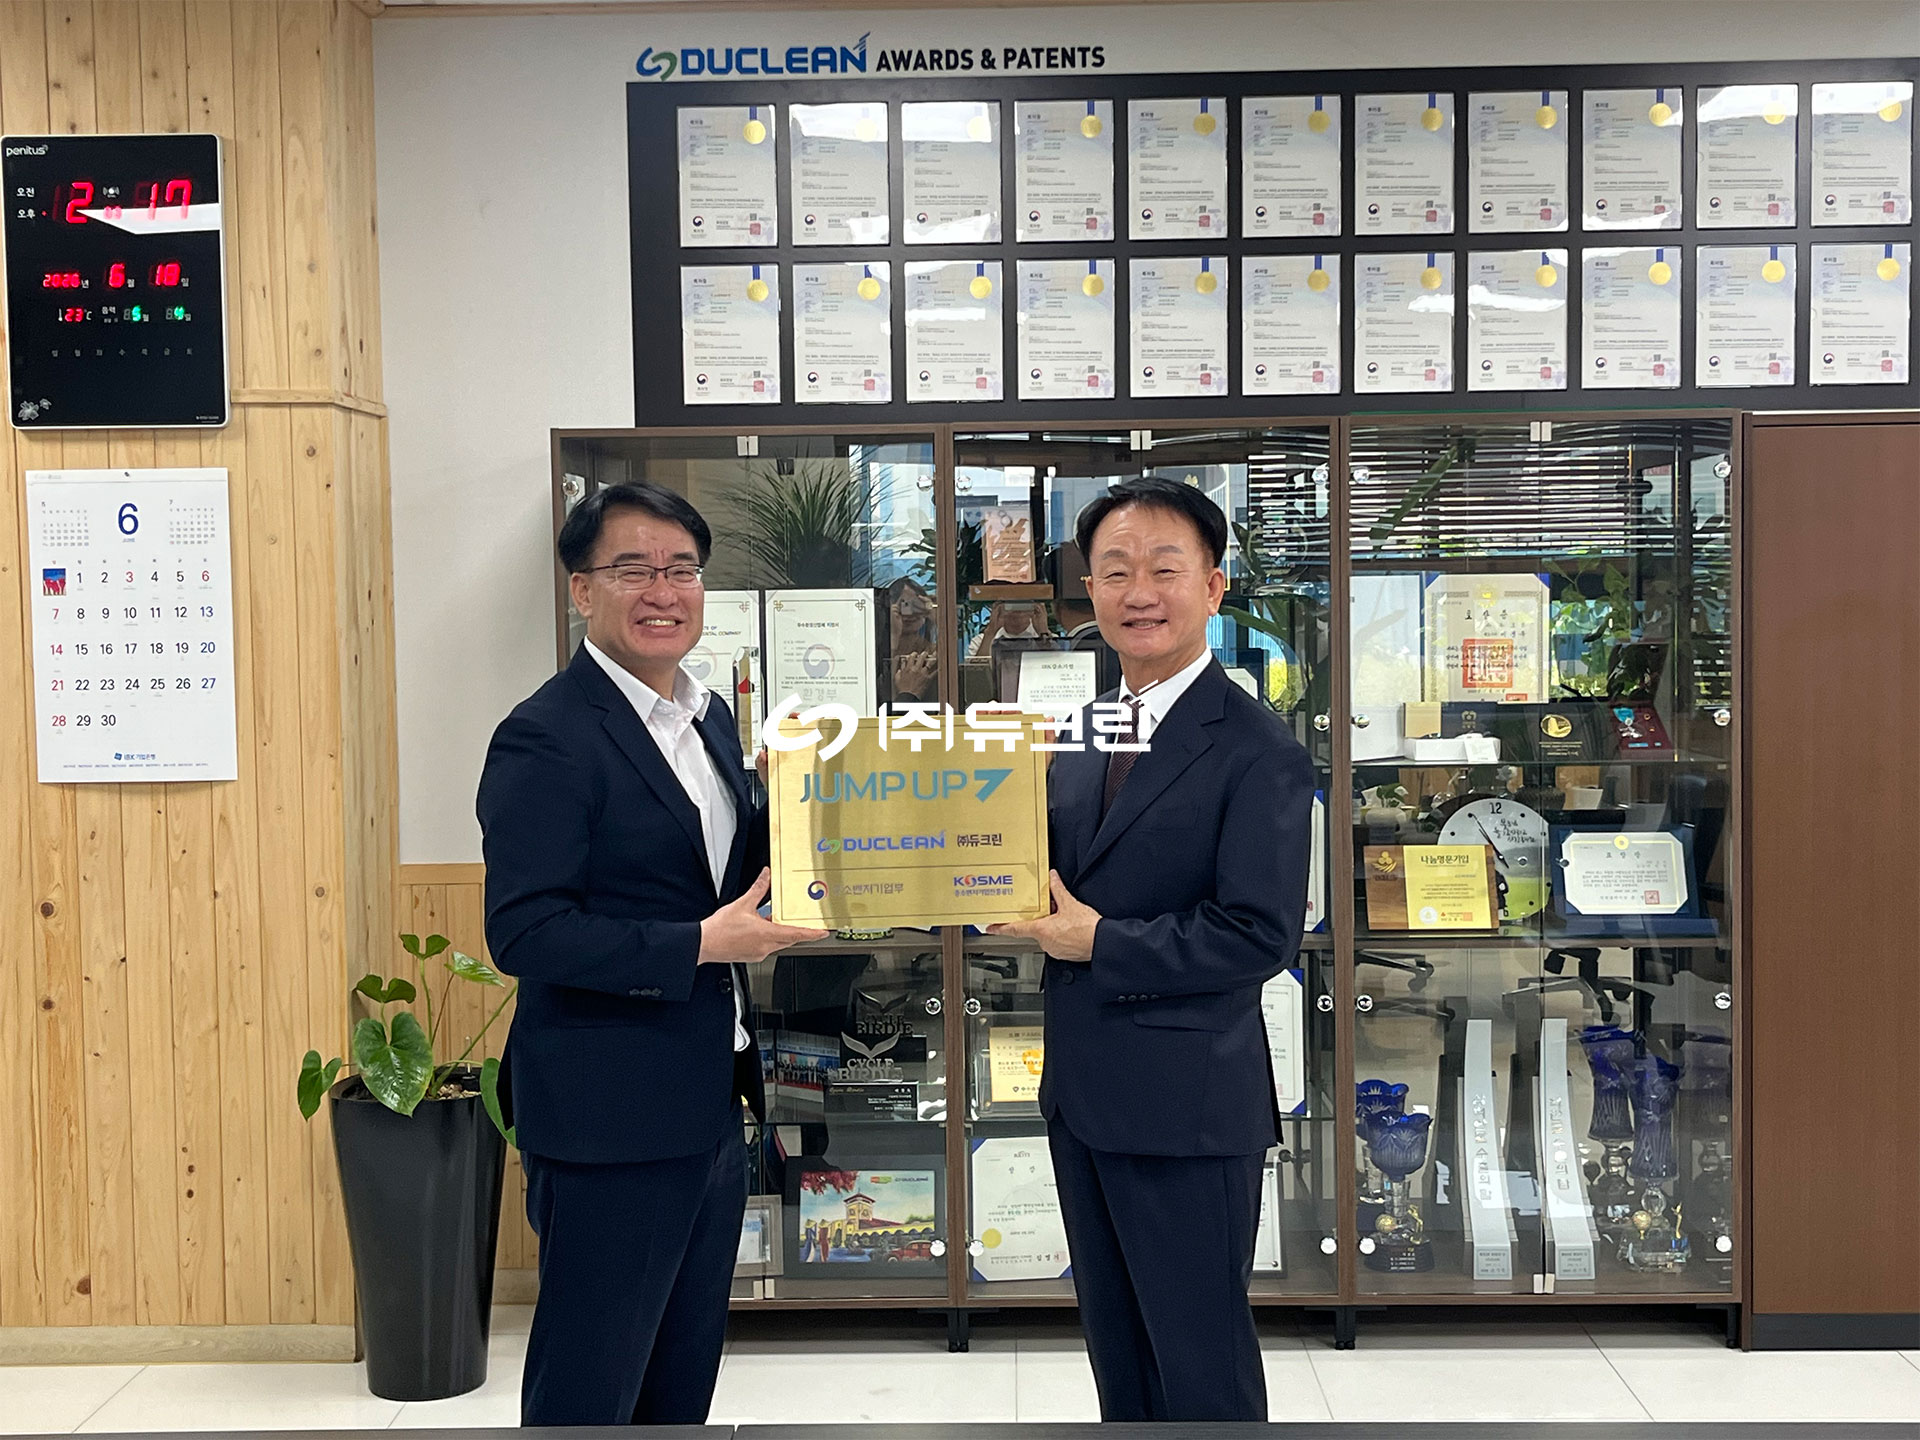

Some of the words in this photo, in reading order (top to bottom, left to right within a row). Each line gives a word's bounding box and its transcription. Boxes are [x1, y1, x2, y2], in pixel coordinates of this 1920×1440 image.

[681, 45, 868, 75] DUCLEAN
[876, 48, 974, 72] AWARDS
[980, 49, 997, 70] &
[1003, 47, 1107, 70] PATENTS
[6, 146, 47, 157] penitus
[16, 187, 35, 198] 오전
[17, 208, 36, 219] 오후
[117, 502, 139, 536] 6
[76, 572, 82, 584] 1
[101, 571, 109, 584] 2
[125, 571, 134, 583] 3
[150, 571, 159, 582] 4
[176, 570, 185, 583] 5
[201, 570, 210, 582] 6
[52, 608, 60, 620] 7
[76, 607, 85, 620] 8
[101, 607, 110, 619] 9
[123, 606, 137, 619] 10
[150, 607, 161, 618] 11
[174, 606, 188, 618] 12
[199, 605, 214, 618] 13
[50, 643, 64, 656] 14
[75, 643, 89, 656] 15
[100, 643, 114, 655] 16
[124, 642, 138, 655] 17
[150, 642, 164, 655] 18
[175, 642, 189, 654] 19
[200, 641, 216, 654] 20
[51, 679, 64, 691] 21
[75, 679, 90, 691] 22
[100, 678, 115, 691] 23
[125, 678, 140, 690] 24
[150, 678, 166, 690] 25
[175, 677, 191, 690] 26
[201, 677, 216, 689] 27
[52, 714, 67, 727] 28
[76, 714, 91, 727] 29
[100, 714, 117, 727] 30
[800, 771, 906, 804] JUMP
[912, 769, 968, 801] UP
[1490, 802, 1502, 814] 12
[842, 836, 946, 852] DUCLEAN
[1421, 854, 1469, 865] 나눔명문기업
[953, 874, 1013, 887] KOSME
[846, 1058, 895, 1069] CYCLE
